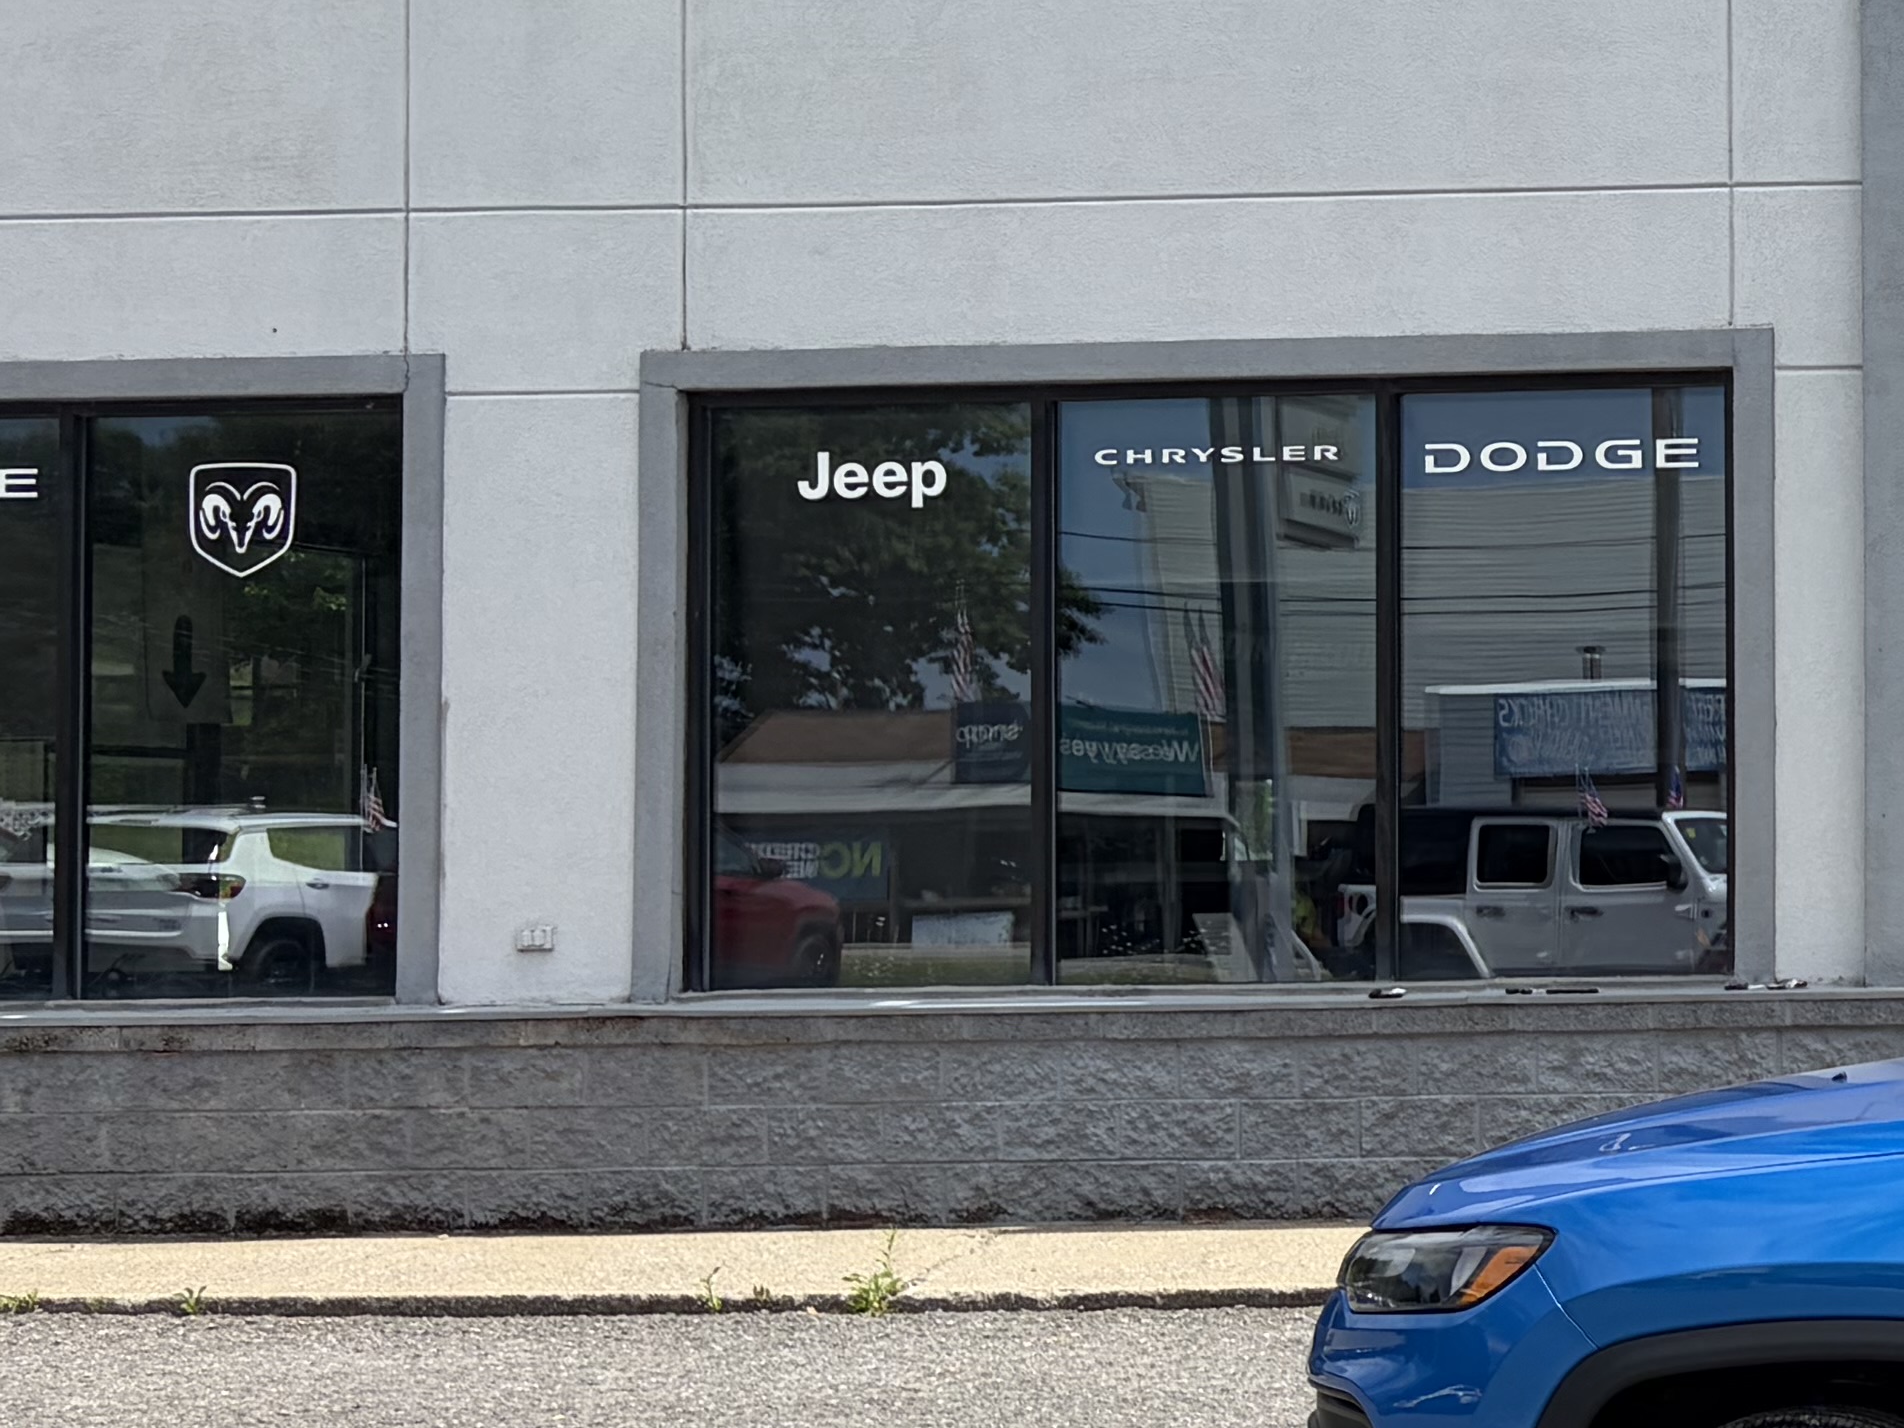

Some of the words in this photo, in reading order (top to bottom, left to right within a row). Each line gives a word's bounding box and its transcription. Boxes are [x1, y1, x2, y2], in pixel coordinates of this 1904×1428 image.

[1094, 445, 1339, 466] CHRYSLER
[1424, 437, 1700, 474] DODGE
[797, 451, 947, 508] Jeep
